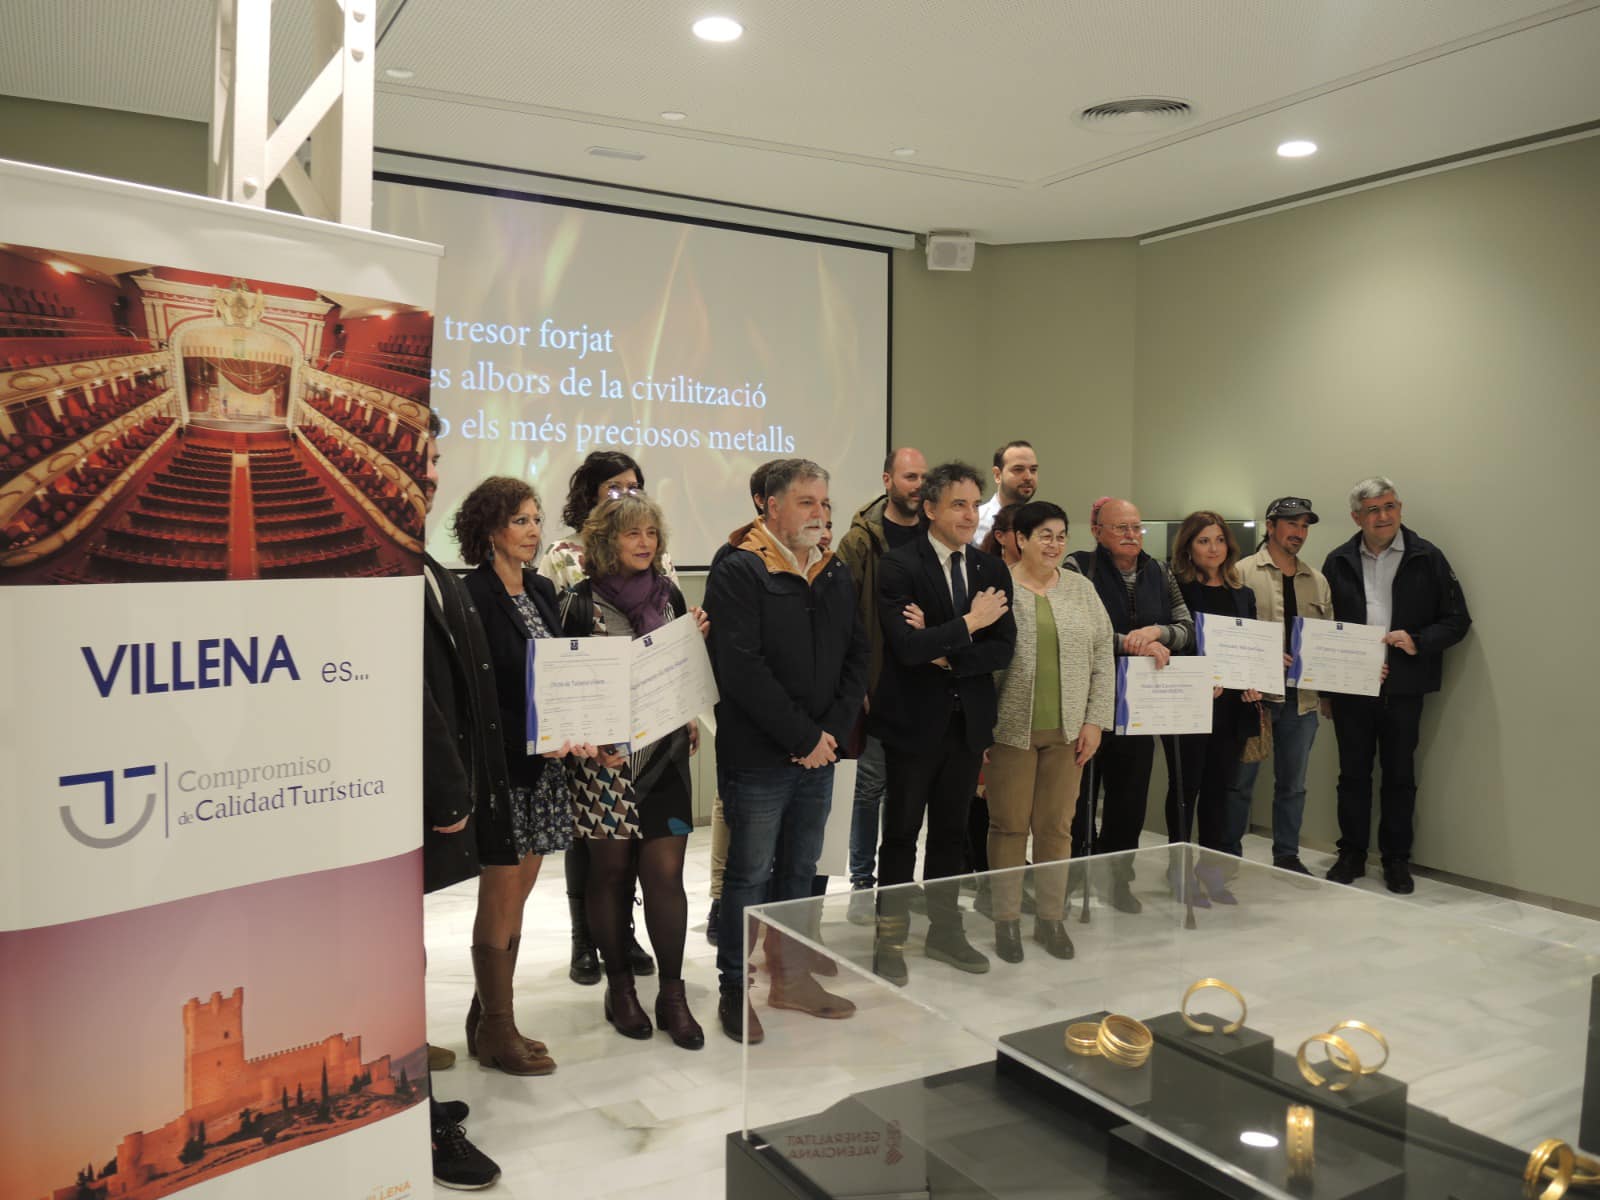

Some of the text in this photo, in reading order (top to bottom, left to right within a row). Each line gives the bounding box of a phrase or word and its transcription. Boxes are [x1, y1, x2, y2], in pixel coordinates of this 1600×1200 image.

[444, 315, 613, 359] tresor forjat
[430, 361, 767, 409] es albors de la civilització
[461, 409, 499, 440] els
[510, 414, 567, 443] més
[575, 419, 700, 451] preciosos
[708, 425, 795, 454] metalls
[80, 634, 369, 698] VILLENA es...
[177, 756, 331, 793] Compromiso
[178, 778, 385, 826] de Calidad Turística
